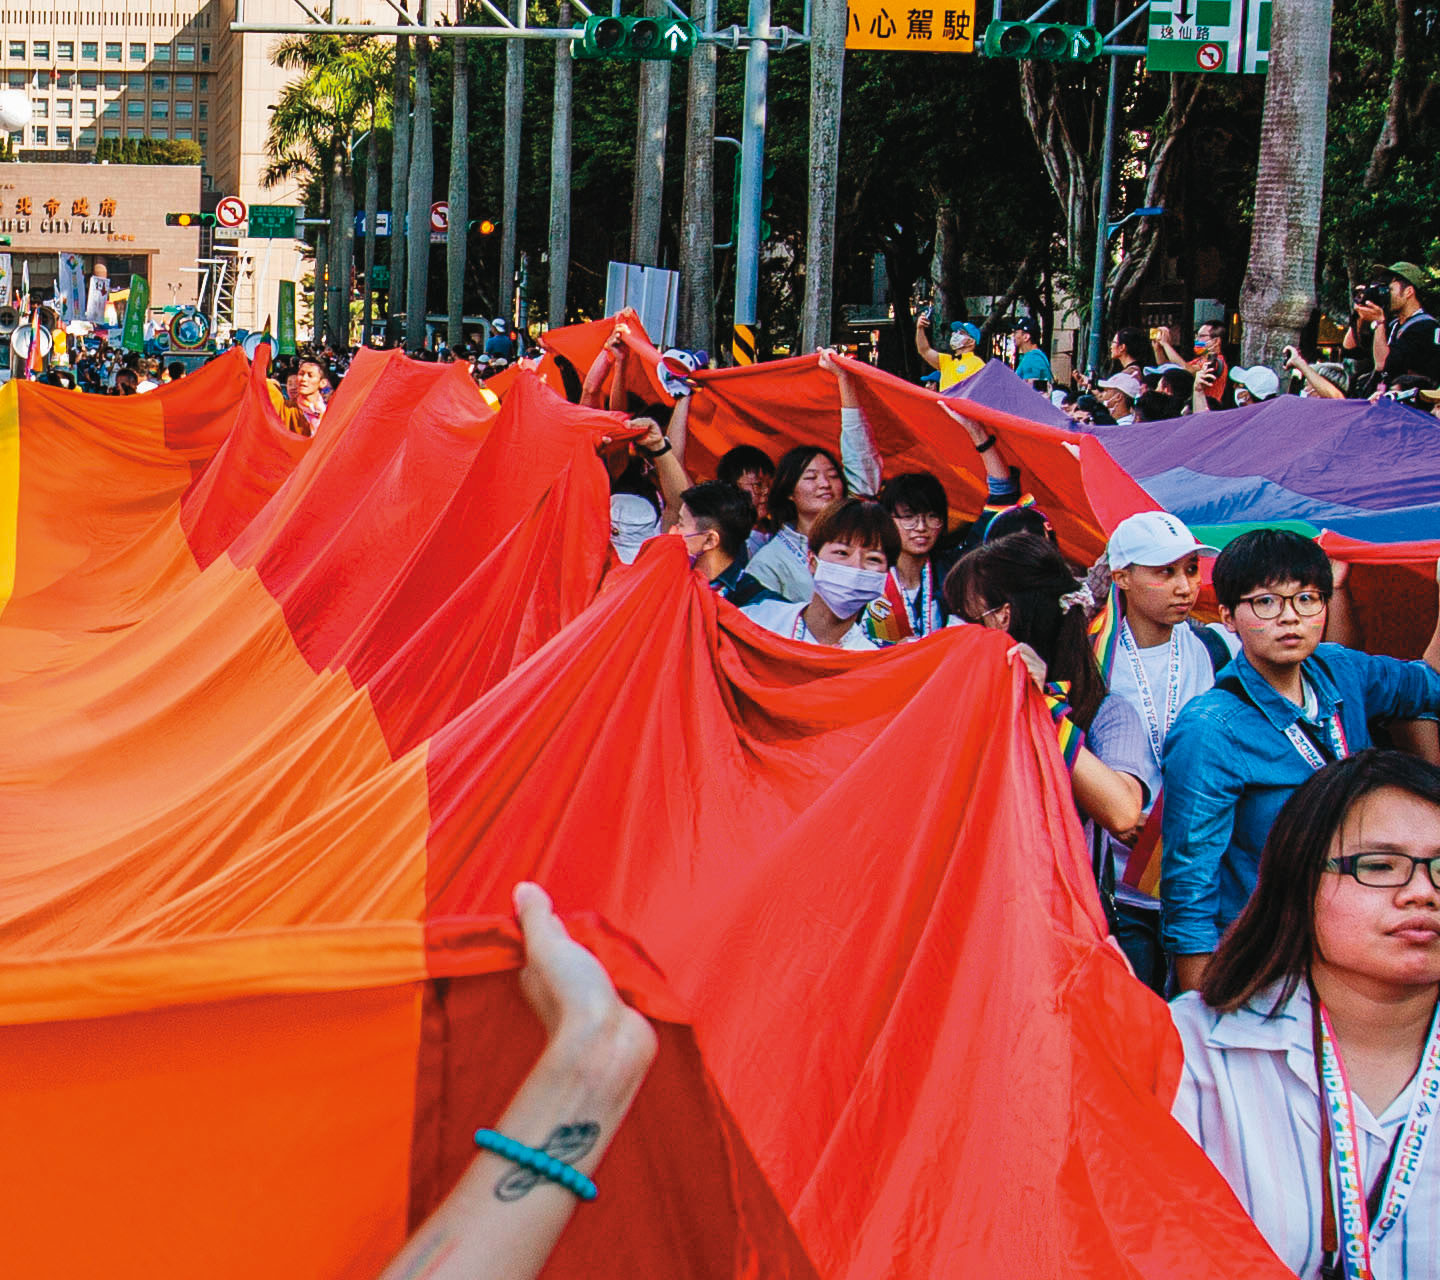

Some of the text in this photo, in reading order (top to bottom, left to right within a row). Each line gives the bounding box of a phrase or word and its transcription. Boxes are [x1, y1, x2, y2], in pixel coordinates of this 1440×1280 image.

[846, 7, 970, 41] 小心駕駛
[41, 219, 73, 234] CITY
[81, 220, 116, 234] HALL
[1335, 1131, 1355, 1153] 18
[1371, 1185, 1406, 1243] LGBT
[1394, 1120, 1428, 1186] PRIDE
[1421, 1077, 1440, 1100] 18
[1338, 1154, 1364, 1236] YEARS
[1346, 1238, 1367, 1270] OF
